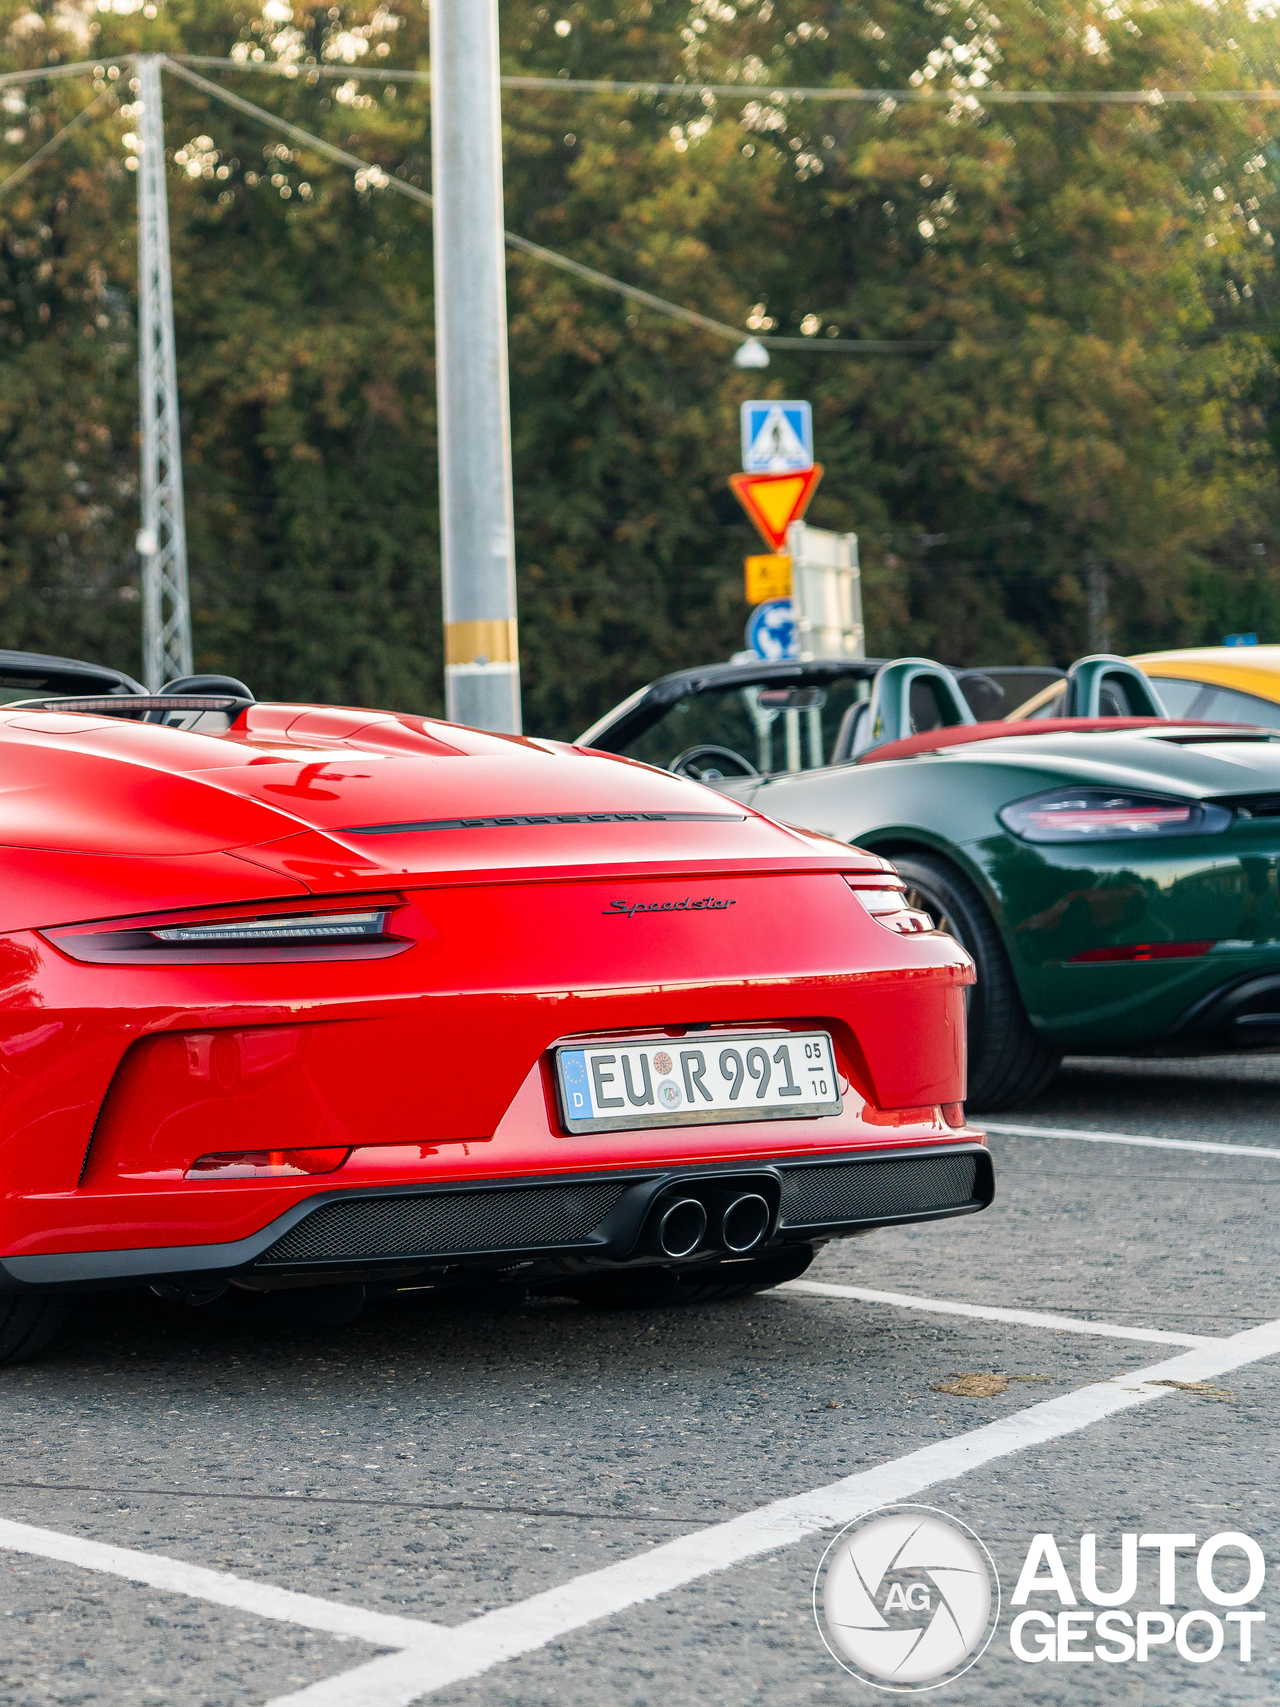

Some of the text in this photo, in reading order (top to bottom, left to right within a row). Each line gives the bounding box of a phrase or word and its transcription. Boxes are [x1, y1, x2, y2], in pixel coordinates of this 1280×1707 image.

[462, 813, 667, 827] PORSCHE
[601, 896, 738, 918] Speedster
[804, 1042, 822, 1060] 05
[590, 1053, 655, 1109] EU
[679, 1049, 714, 1103] R
[718, 1044, 803, 1100] 991
[810, 1079, 828, 1097] 10
[572, 1091, 584, 1108] D
